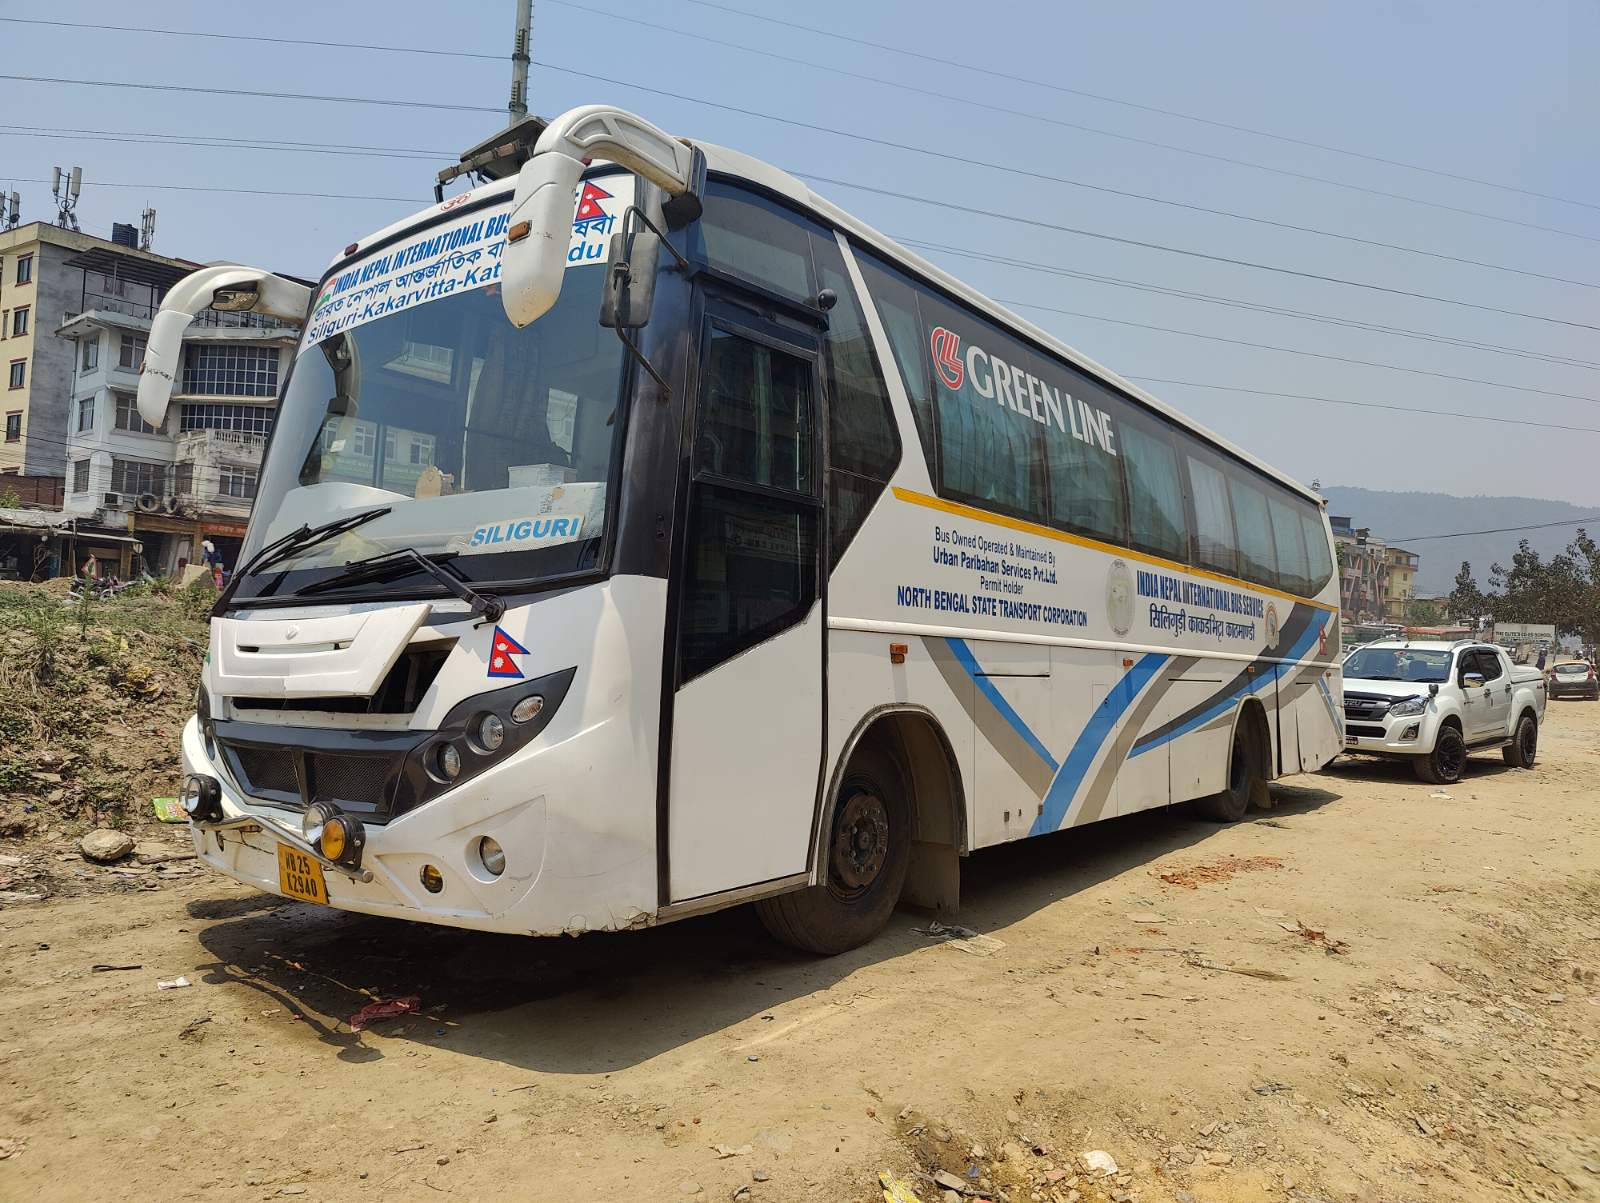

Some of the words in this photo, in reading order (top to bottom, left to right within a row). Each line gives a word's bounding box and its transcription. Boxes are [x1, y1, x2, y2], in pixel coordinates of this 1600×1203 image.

[332, 268, 361, 296] INDIA
[360, 254, 393, 286] NEPAL
[392, 220, 484, 271] INTERNATIONAL
[313, 297, 346, 322] ভারত
[347, 279, 392, 308] নেপাল
[395, 247, 484, 288] আন্তর্জাতিক
[488, 238, 508, 259] বা
[966, 345, 1065, 433] GREEN
[1065, 393, 1117, 457] LINE
[470, 517, 580, 547] SILIGURI
[934, 526, 950, 544] Bus
[951, 529, 977, 547] Owned
[978, 535, 1008, 556] Operated
[1009, 543, 1015, 556] &
[1015, 544, 1047, 563] Maintained
[1048, 551, 1056, 568] By
[933, 546, 959, 567] Urban
[960, 551, 1000, 573] Paribahan
[1001, 559, 1032, 580] Services
[897, 585, 932, 609] NORTH
[934, 590, 970, 614] BENGAL
[971, 596, 997, 616] STATE
[998, 599, 1042, 622] TRANSPORT
[1042, 605, 1088, 627] CORPORATION
[980, 575, 1002, 592] Permit
[1002, 579, 1024, 595] Holder
[1136, 570, 1159, 598] INDIA
[1159, 575, 1182, 603] NEPAL
[1182, 580, 1231, 612] INTERNATIONAL
[1231, 591, 1243, 615] BUS
[1242, 594, 1264, 619] SERVICE
[285, 851, 297, 872] WB
[297, 855, 311, 875] 25
[287, 872, 318, 897] K2940
